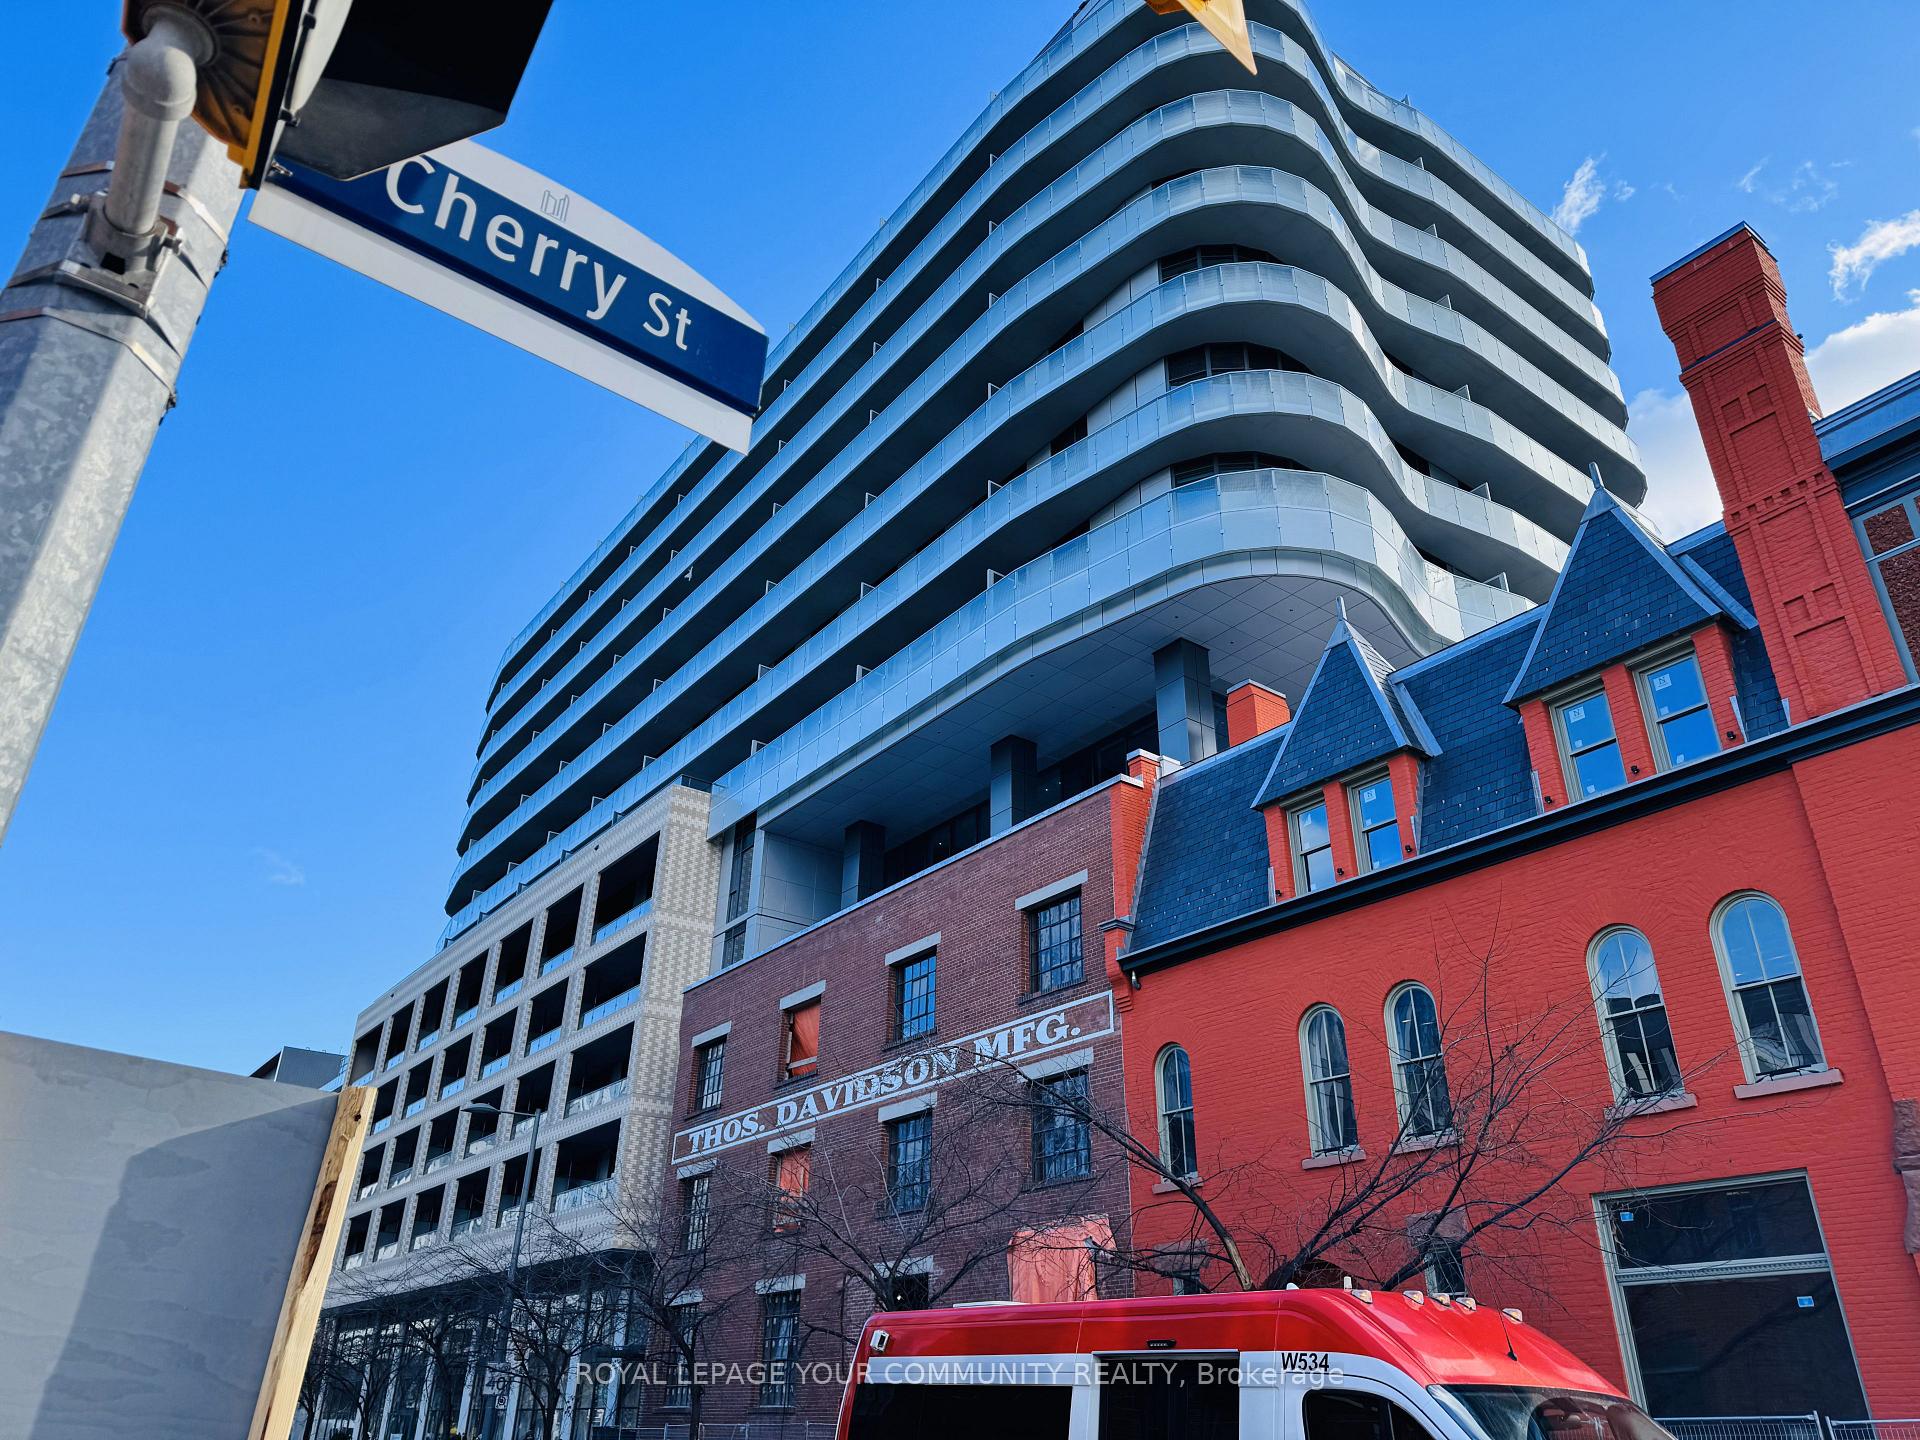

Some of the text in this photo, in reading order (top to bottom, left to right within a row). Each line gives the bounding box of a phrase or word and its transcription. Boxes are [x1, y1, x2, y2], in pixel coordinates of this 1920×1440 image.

[386, 155, 692, 351] Cherry St
[688, 1012, 1081, 1154] THOS. DAVIDSON MFG.
[1281, 1352, 1330, 1372] W534
